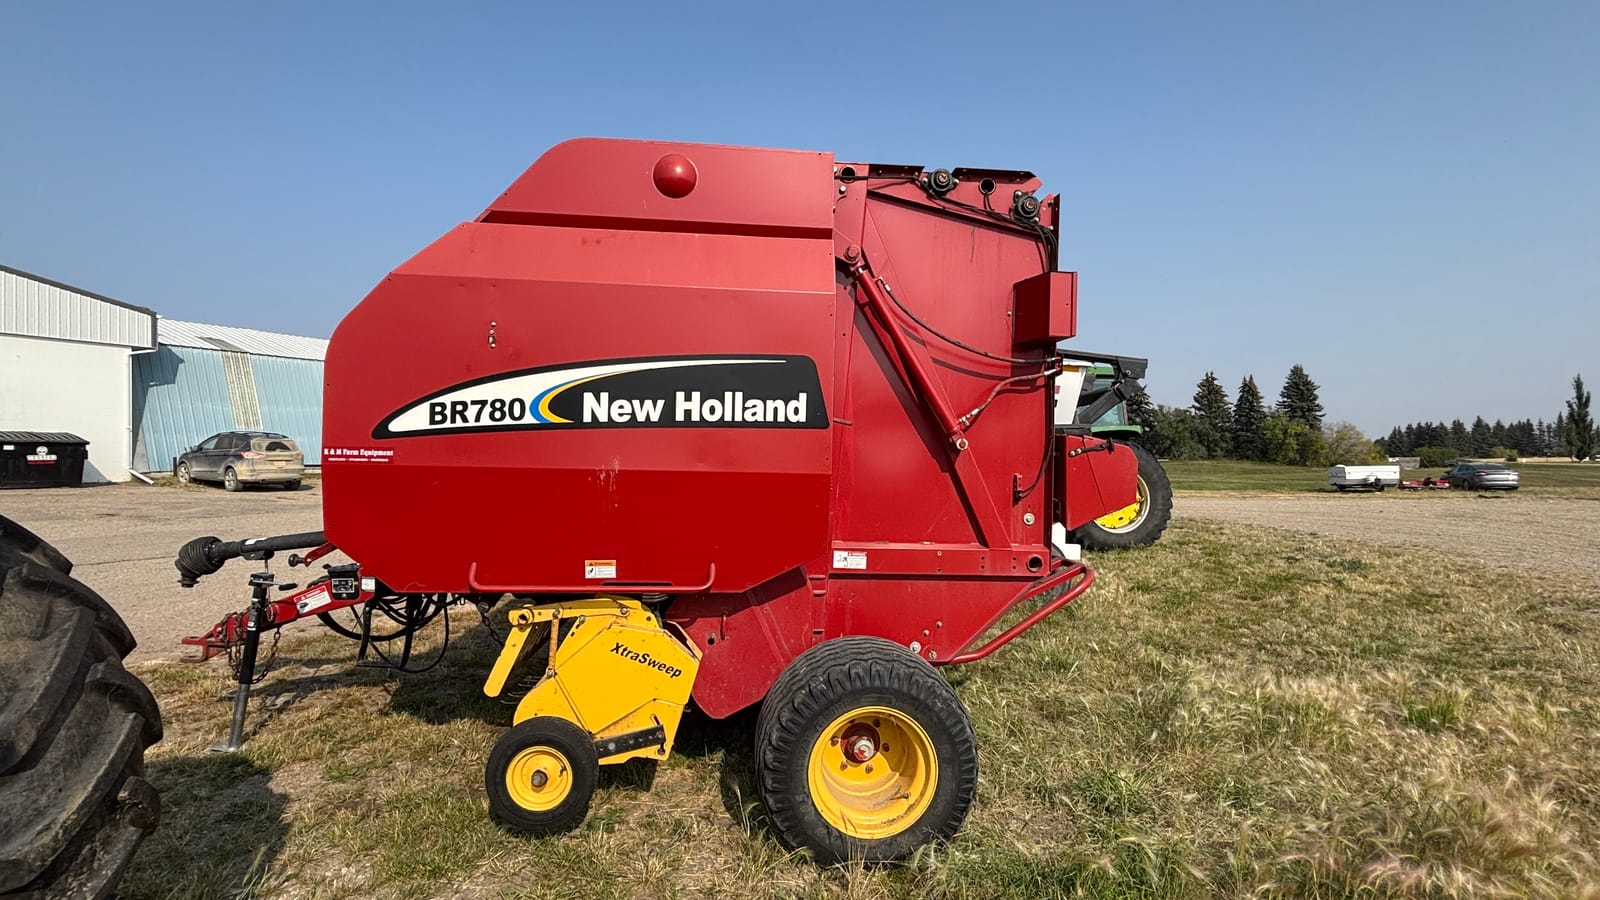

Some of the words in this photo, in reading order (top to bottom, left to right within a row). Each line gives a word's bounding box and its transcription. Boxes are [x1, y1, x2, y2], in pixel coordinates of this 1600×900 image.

[428, 398, 526, 426] BR780
[582, 391, 666, 423] New
[674, 391, 808, 423] Holland
[343, 448, 359, 456] Farm
[360, 448, 393, 457] Equipment
[609, 641, 682, 679] XtraSweep
